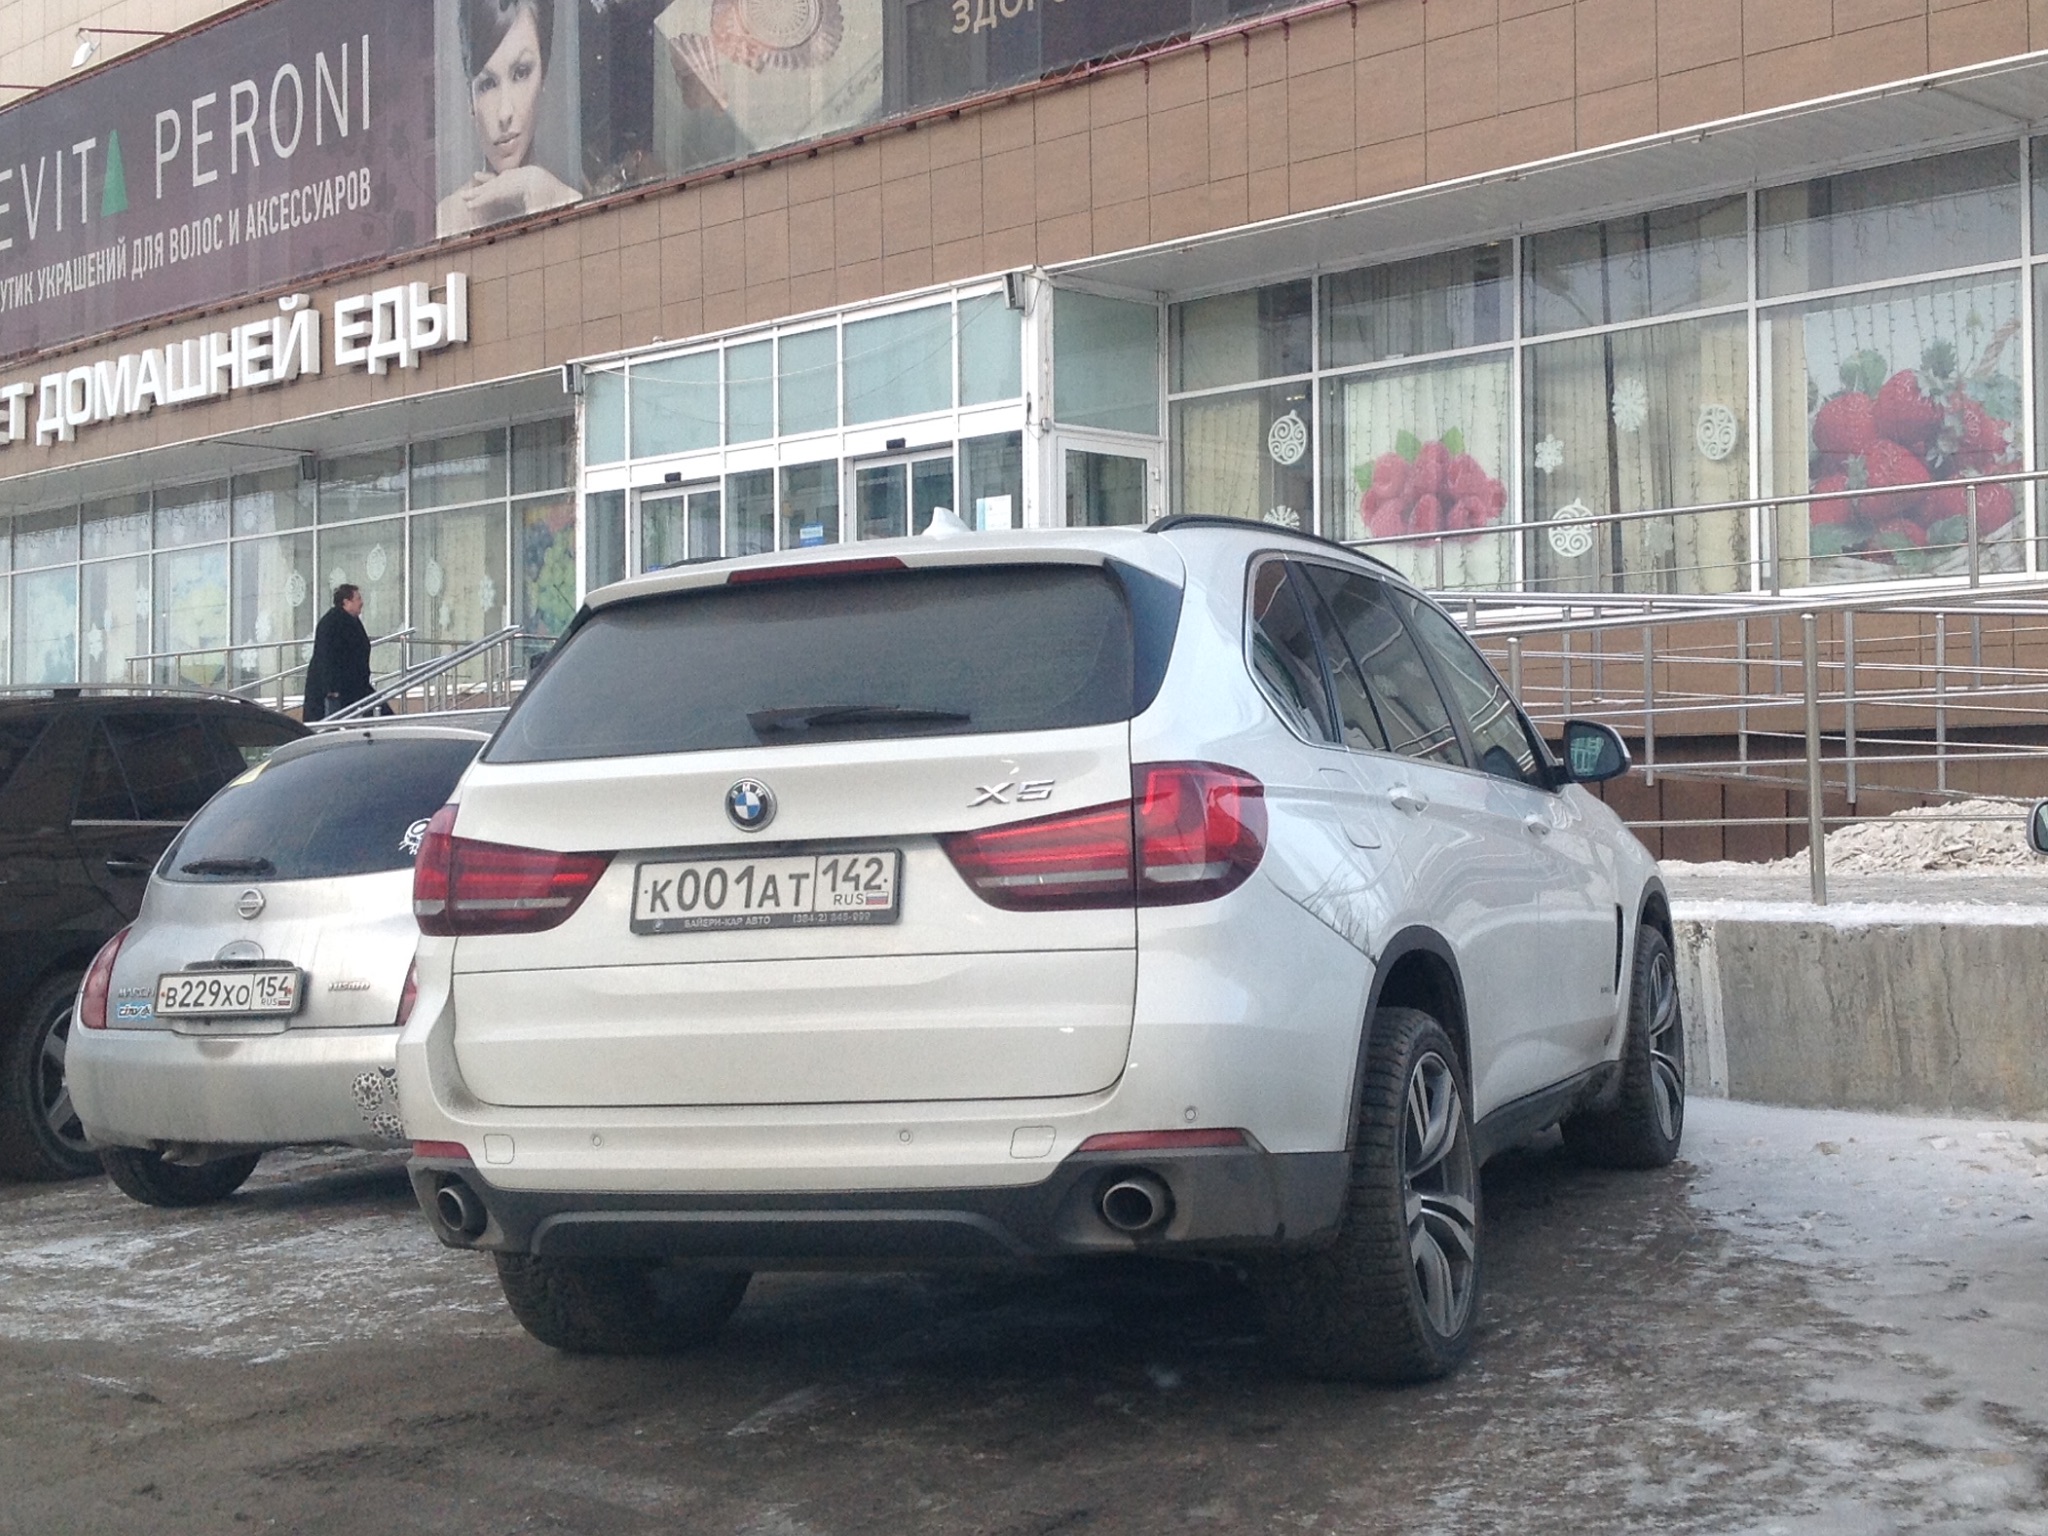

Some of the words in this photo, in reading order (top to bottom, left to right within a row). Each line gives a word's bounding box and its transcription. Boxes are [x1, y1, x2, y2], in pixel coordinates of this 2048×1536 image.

[155, 35, 370, 199] PERONI
[37, 236, 127, 301] УКРАШЕНИЙ
[131, 231, 164, 281] ДЛЯ
[169, 213, 223, 264] ВОЛОС
[229, 208, 240, 246] И
[245, 167, 371, 242] АКСЕССУАРОВ
[36, 294, 320, 446] ДОМАШНЕЙ
[334, 272, 468, 375] ЕДЫ
[967, 779, 1055, 807] X5
[822, 857, 884, 892] 142
[833, 893, 864, 906] RUS
